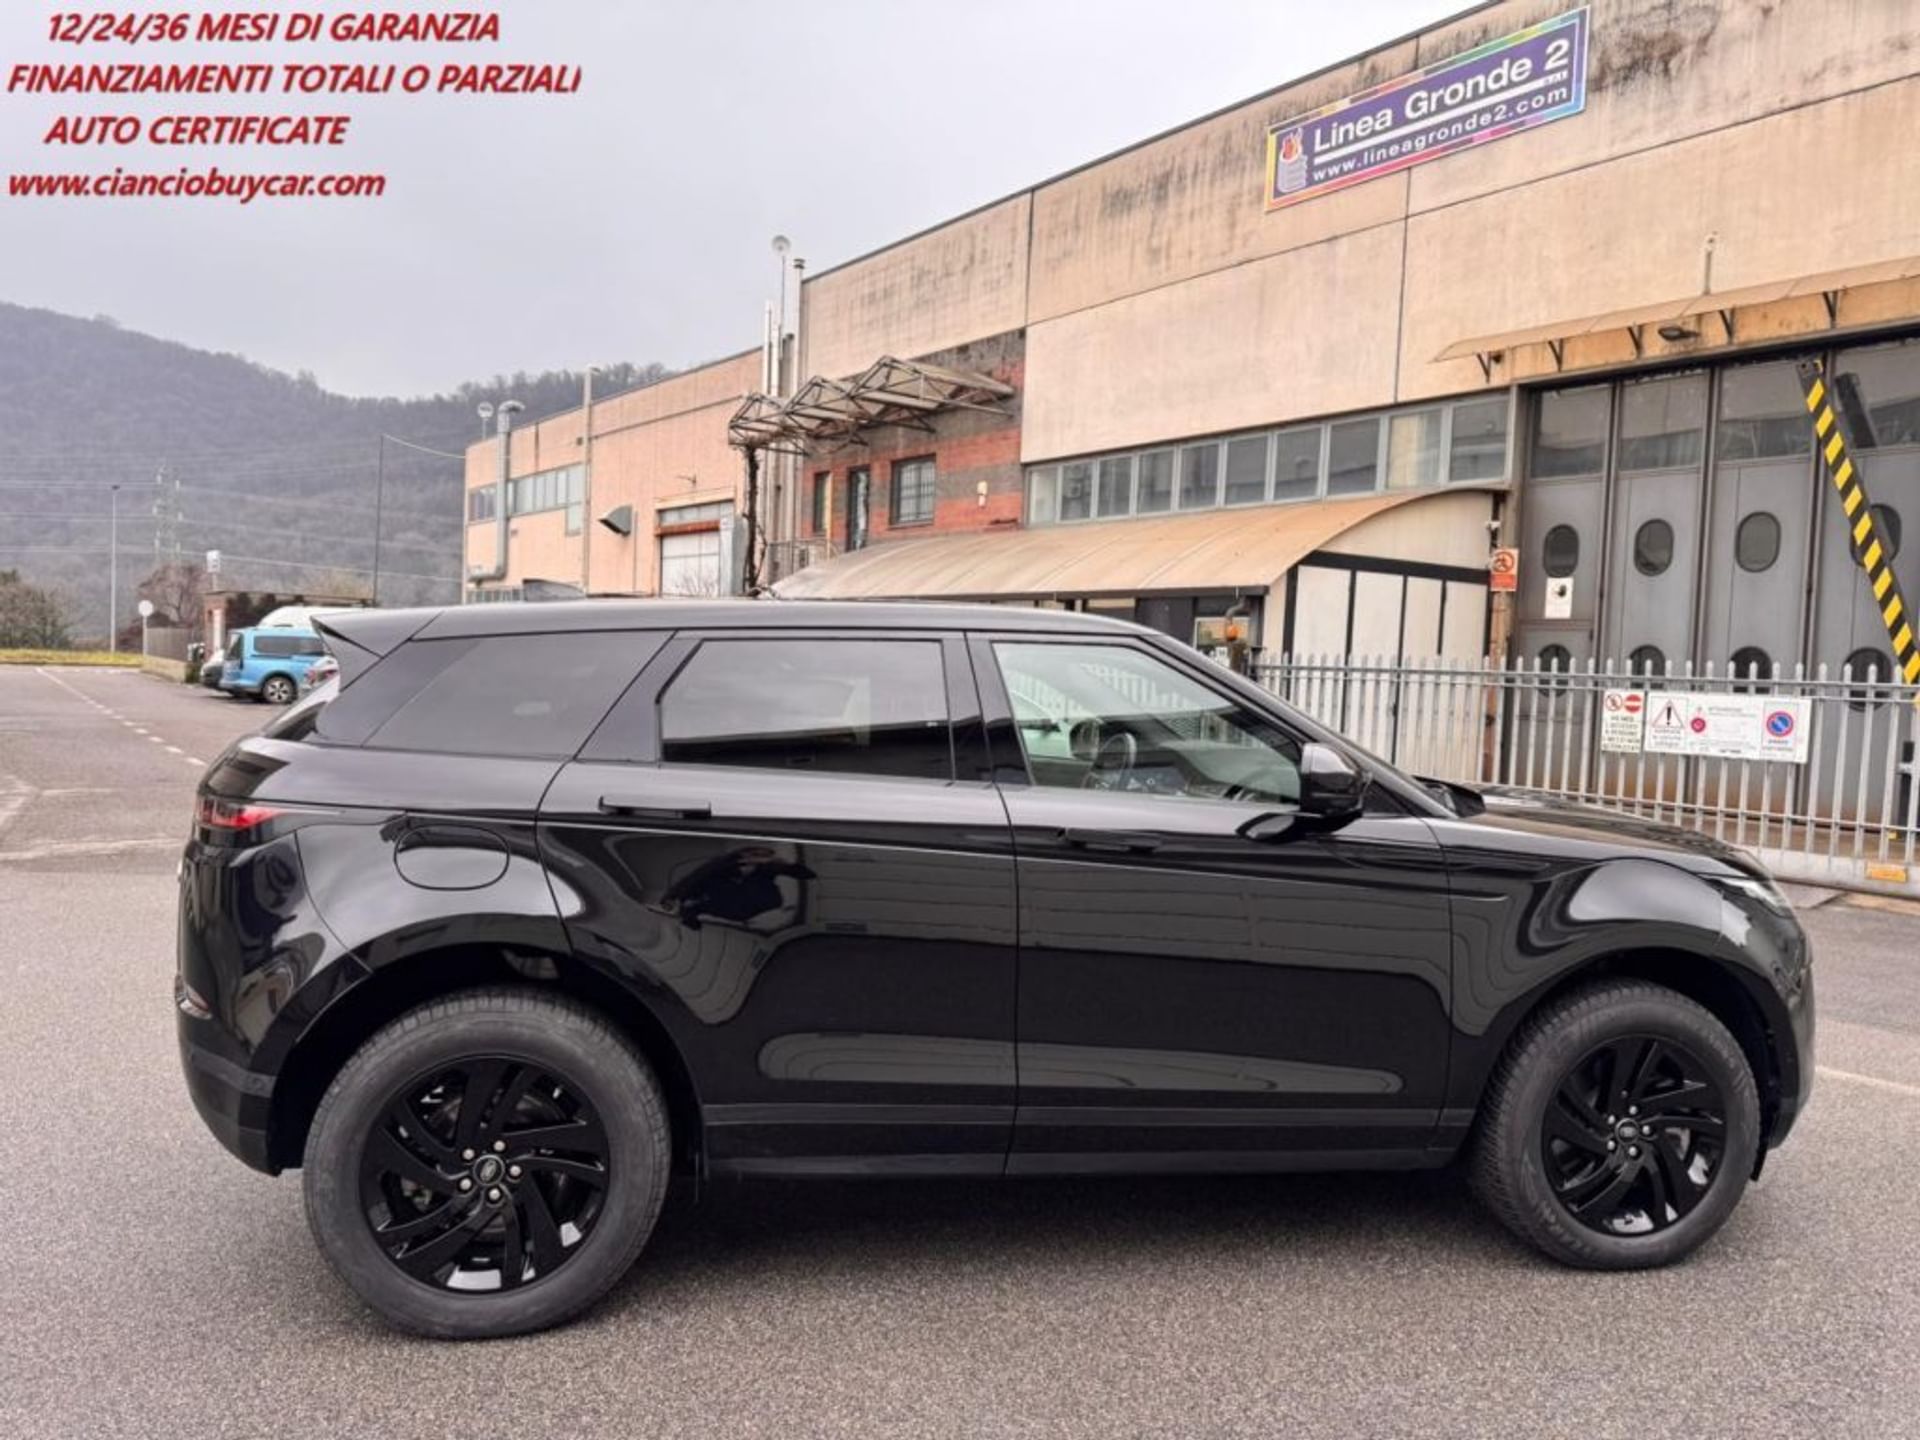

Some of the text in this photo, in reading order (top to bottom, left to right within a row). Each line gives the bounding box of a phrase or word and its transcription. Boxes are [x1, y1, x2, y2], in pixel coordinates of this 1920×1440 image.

[1313, 87, 1569, 181] www.lineagronde2.com
[1314, 38, 1570, 153] Linea Gronde 2
